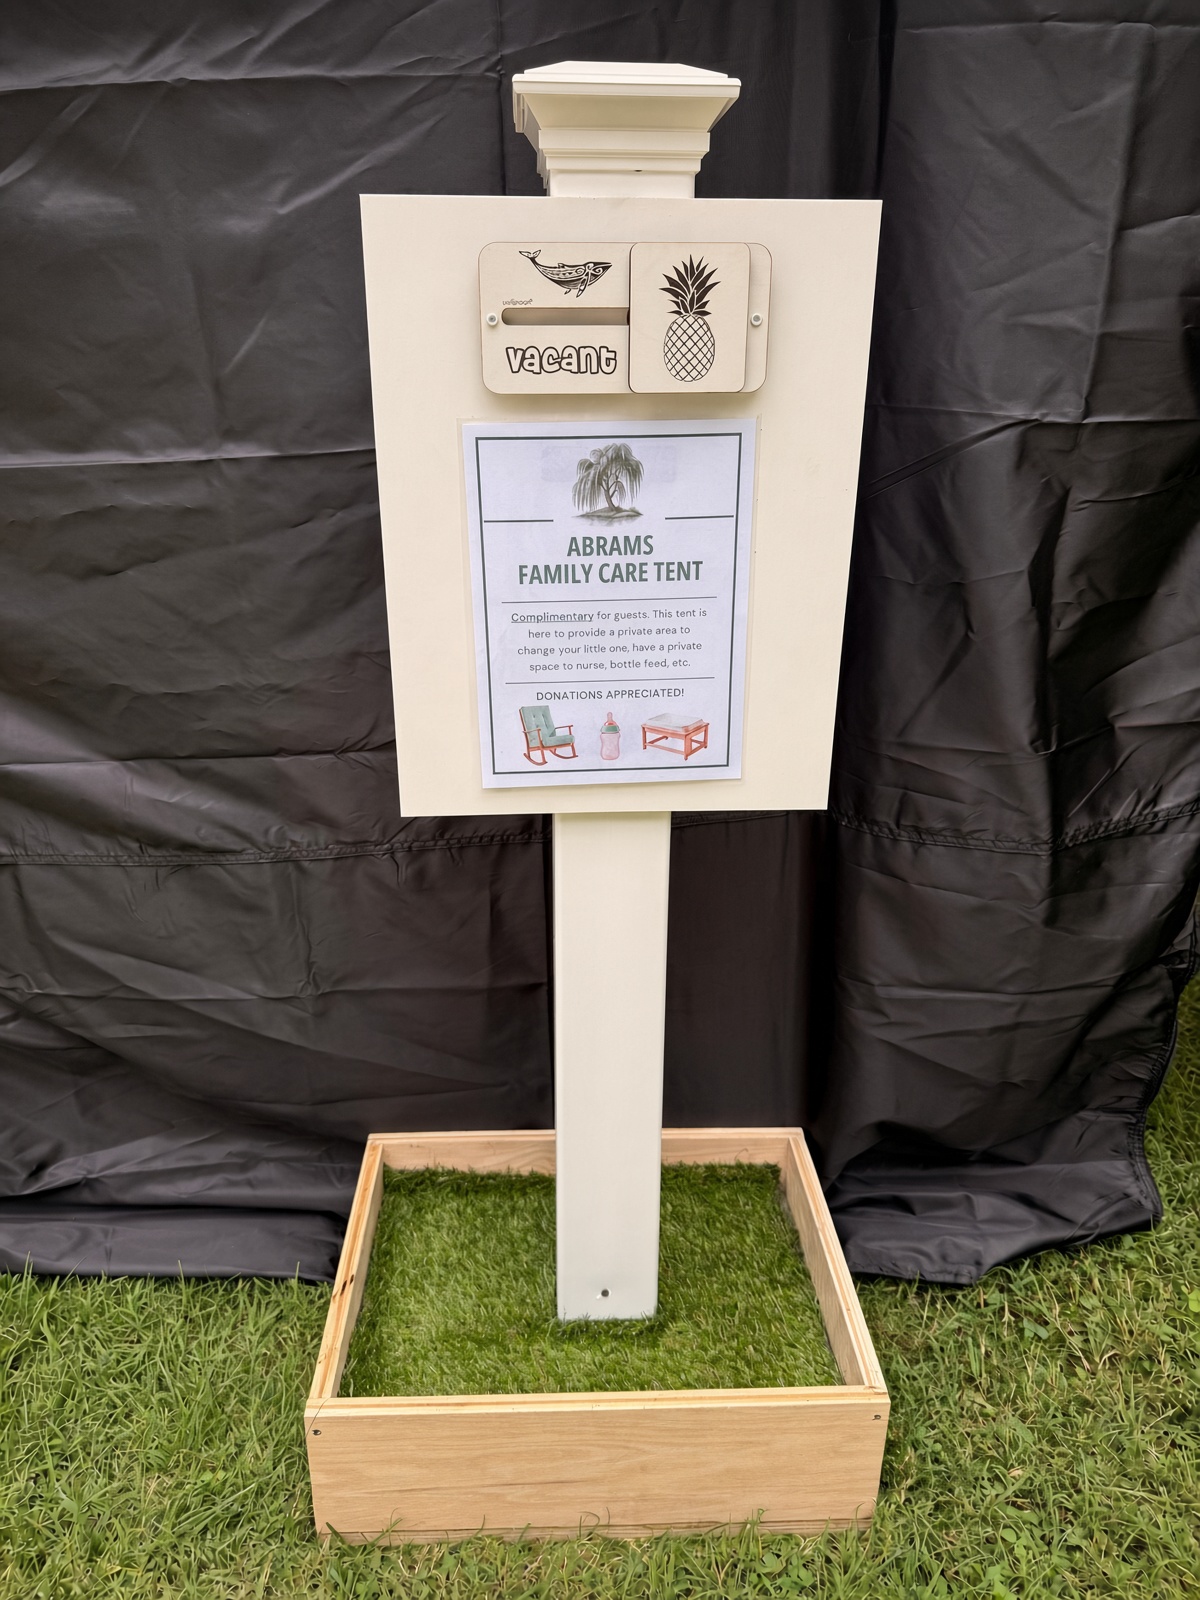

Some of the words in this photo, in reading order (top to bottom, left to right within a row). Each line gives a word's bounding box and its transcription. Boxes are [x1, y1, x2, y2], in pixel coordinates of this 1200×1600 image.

[505, 345, 617, 374] vacant
[567, 535, 654, 557] ABRAMS
[518, 563, 593, 585] FAMILY
[598, 562, 648, 584] CARE
[653, 560, 703, 582] TENT
[511, 612, 594, 623] Complimentary
[597, 611, 611, 620] for
[614, 611, 650, 622] guests.
[653, 609, 673, 618] This
[676, 610, 696, 618] tent
[699, 608, 707, 617] is
[528, 629, 551, 638] here
[554, 630, 565, 638] to
[568, 628, 606, 640] provide
[617, 627, 653, 638] private
[655, 627, 678, 635] area
[680, 626, 691, 634] to
[517, 646, 555, 657] change
[558, 647, 581, 656] your
[583, 644, 607, 654] little
[609, 646, 630, 654] one,
[632, 643, 656, 652] have
[667, 642, 702, 653] private
[529, 663, 560, 673] space
[563, 662, 573, 671] to
[576, 662, 607, 671] nurse,
[610, 659, 641, 669] bottle
[644, 658, 670, 669] feed,
[672, 659, 691, 668] etc.
[536, 690, 603, 701] DONATIONS
[606, 688, 684, 700] APPRECIATED!
